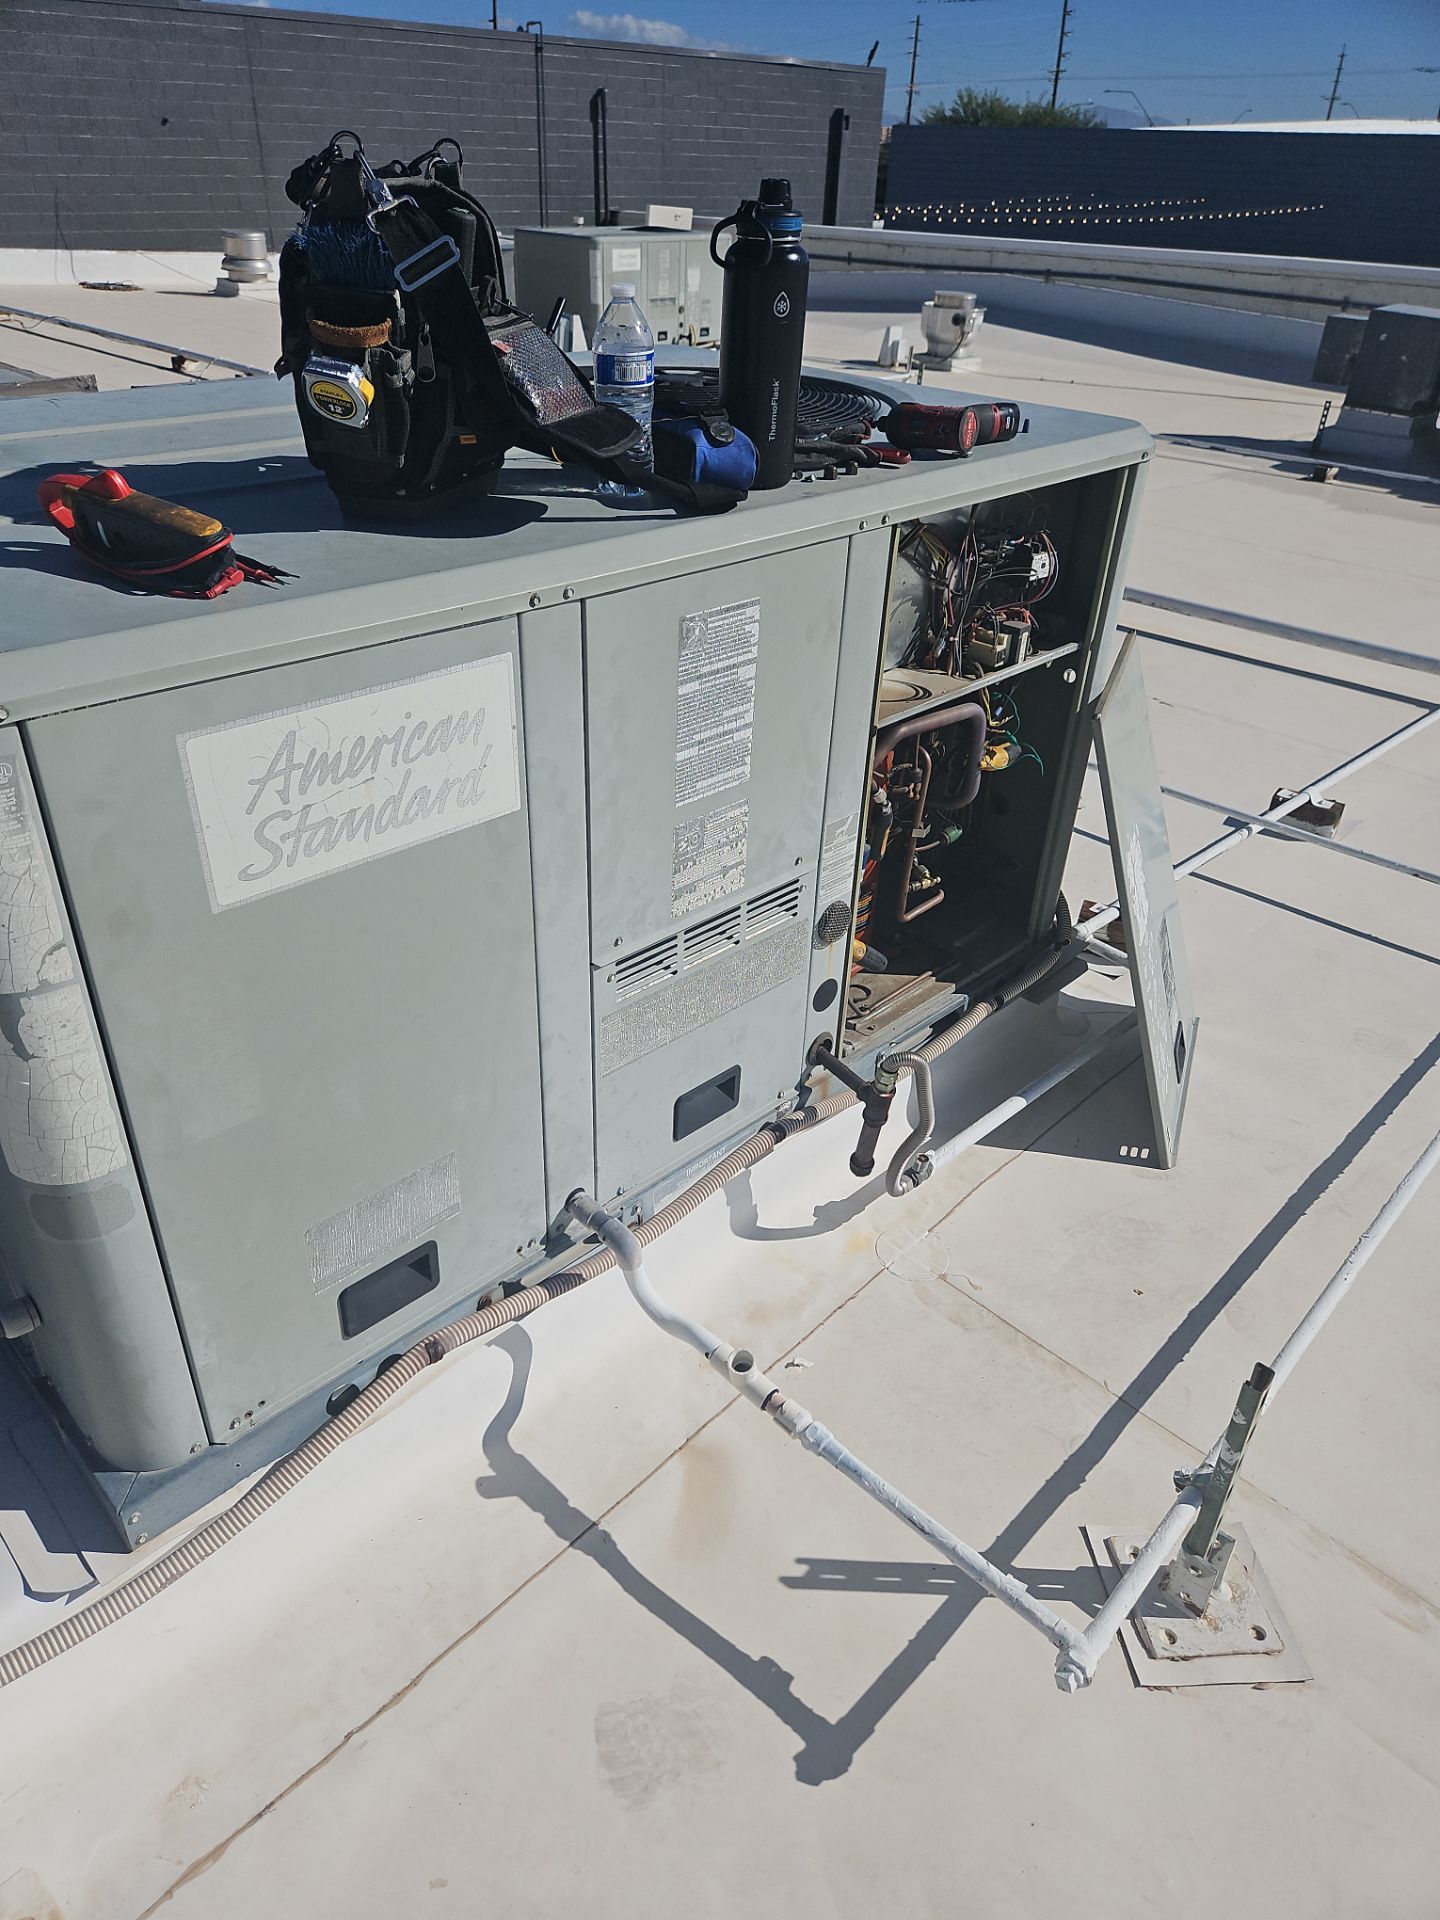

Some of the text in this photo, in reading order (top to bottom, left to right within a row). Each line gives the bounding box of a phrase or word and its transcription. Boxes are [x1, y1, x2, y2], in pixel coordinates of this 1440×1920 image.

[768, 380, 780, 442] ThermoFlask
[245, 707, 486, 815] American
[237, 744, 493, 882] Standard
[686, 1147, 727, 1177] IMPORTANT
